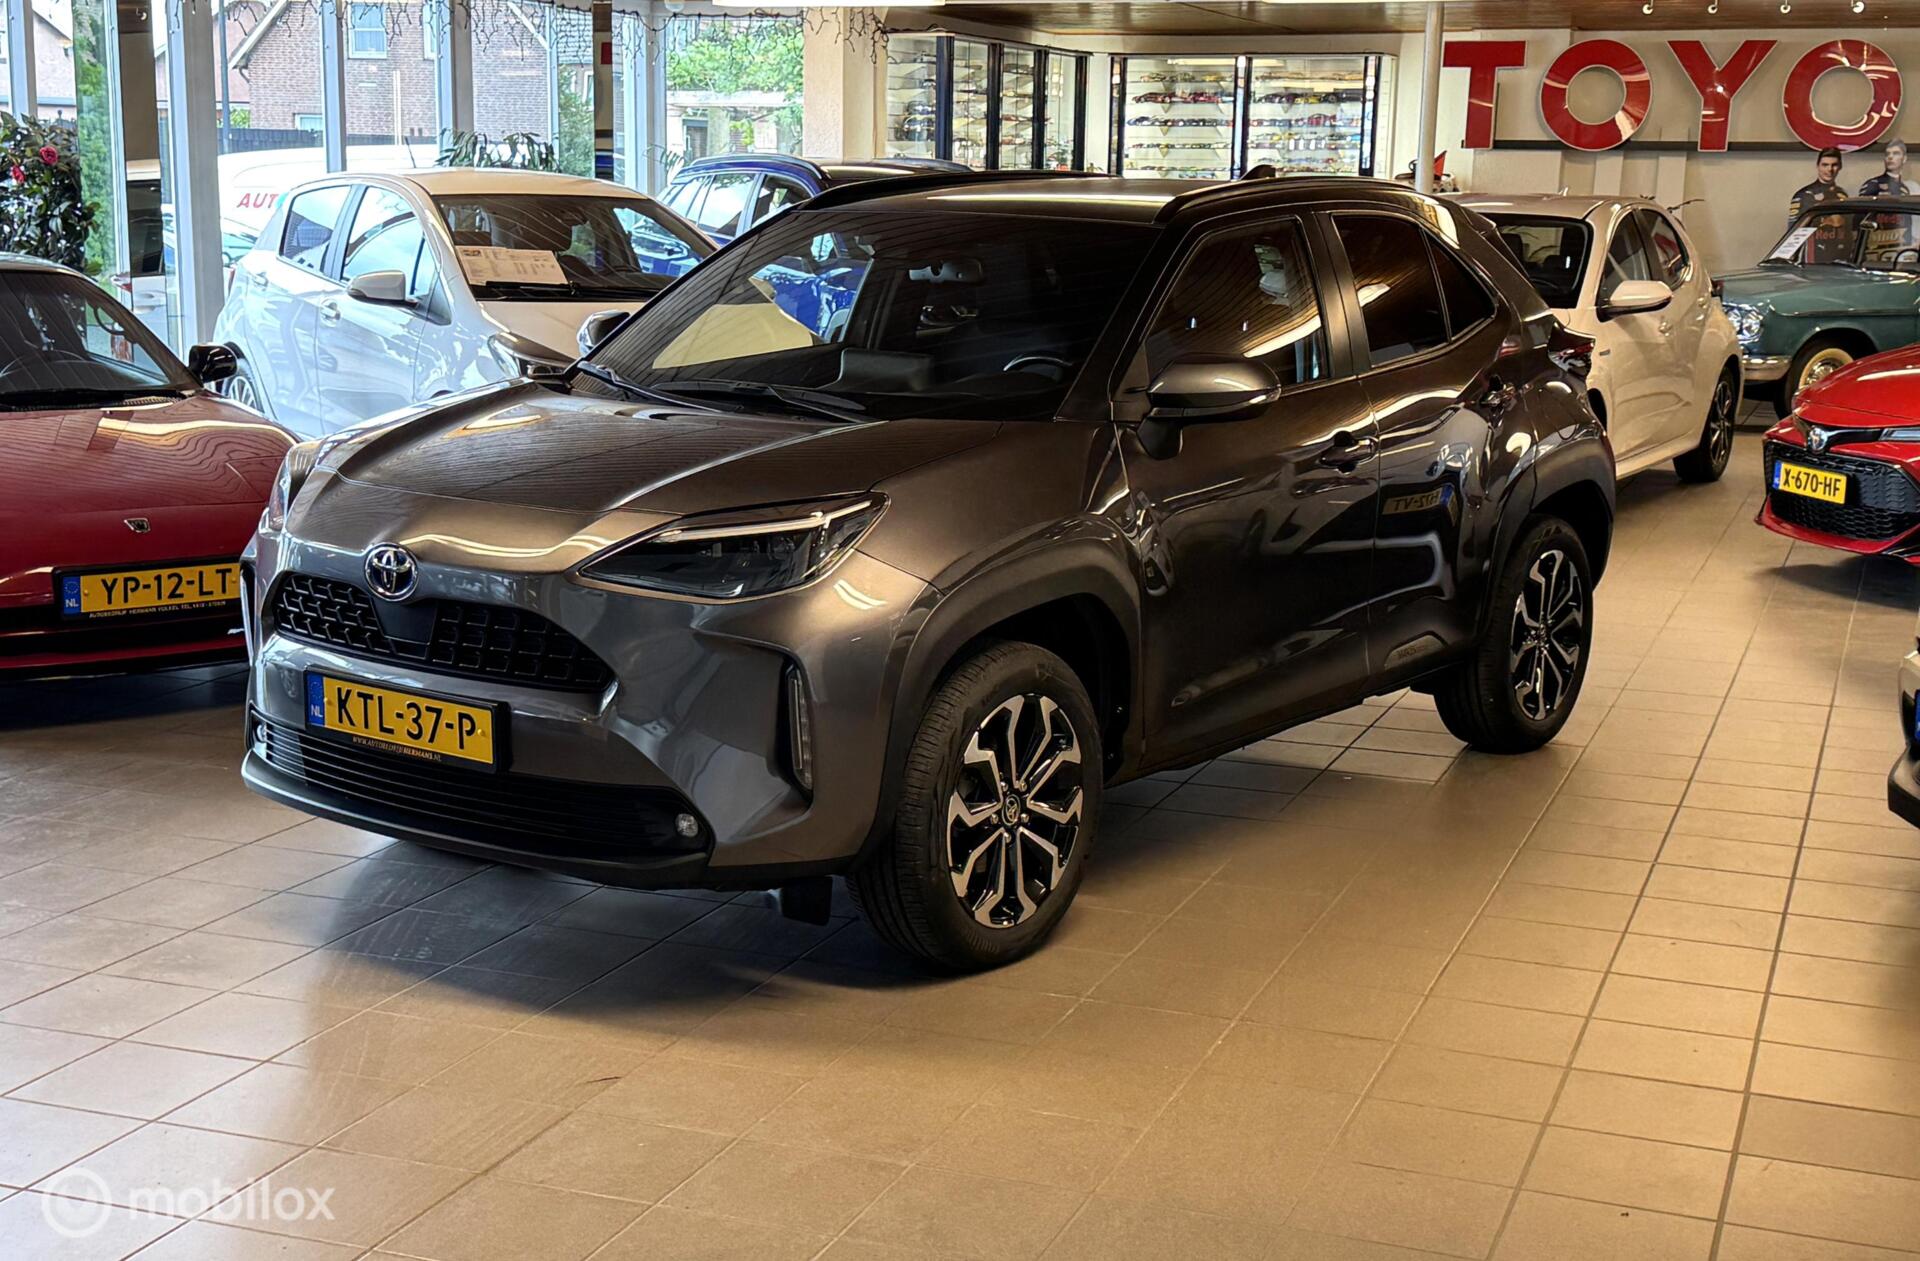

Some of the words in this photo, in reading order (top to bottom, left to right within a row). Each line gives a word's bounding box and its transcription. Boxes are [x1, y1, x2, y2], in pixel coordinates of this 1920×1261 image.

[1443, 38, 1903, 152] TOYO
[236, 193, 280, 208] AUT
[1783, 468, 1842, 497] X-670-HF
[101, 568, 233, 605] YP-12-LT
[65, 599, 80, 608] NL
[311, 704, 323, 718] NL
[337, 687, 476, 750] KTL-37-P
